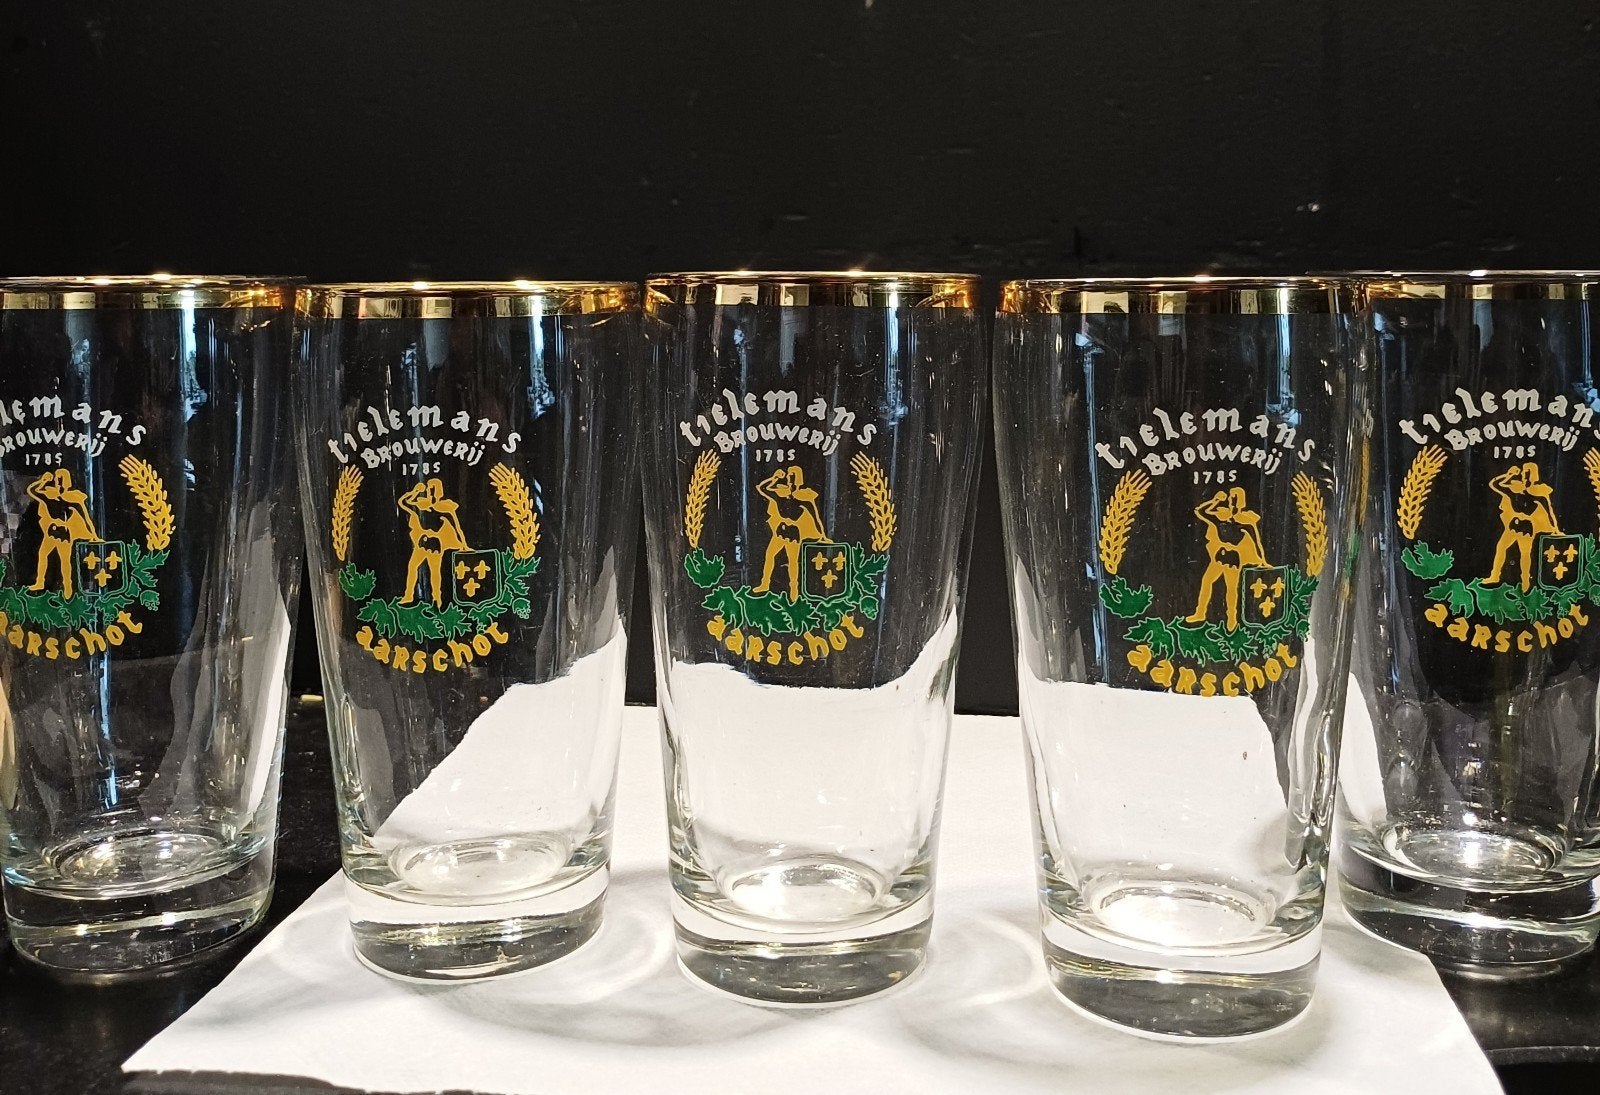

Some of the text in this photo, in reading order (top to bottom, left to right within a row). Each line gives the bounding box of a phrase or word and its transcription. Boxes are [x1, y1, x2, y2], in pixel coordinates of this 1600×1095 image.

[679, 388, 877, 446] tielemans
[328, 405, 521, 463] tielemans
[1095, 407, 1315, 469] tielemans
[25, 453, 63, 466] 1785
[756, 449, 796, 462] 1785
[1493, 445, 1536, 459] 1785
[402, 461, 441, 475] 1785
[1193, 469, 1238, 485] 1785
